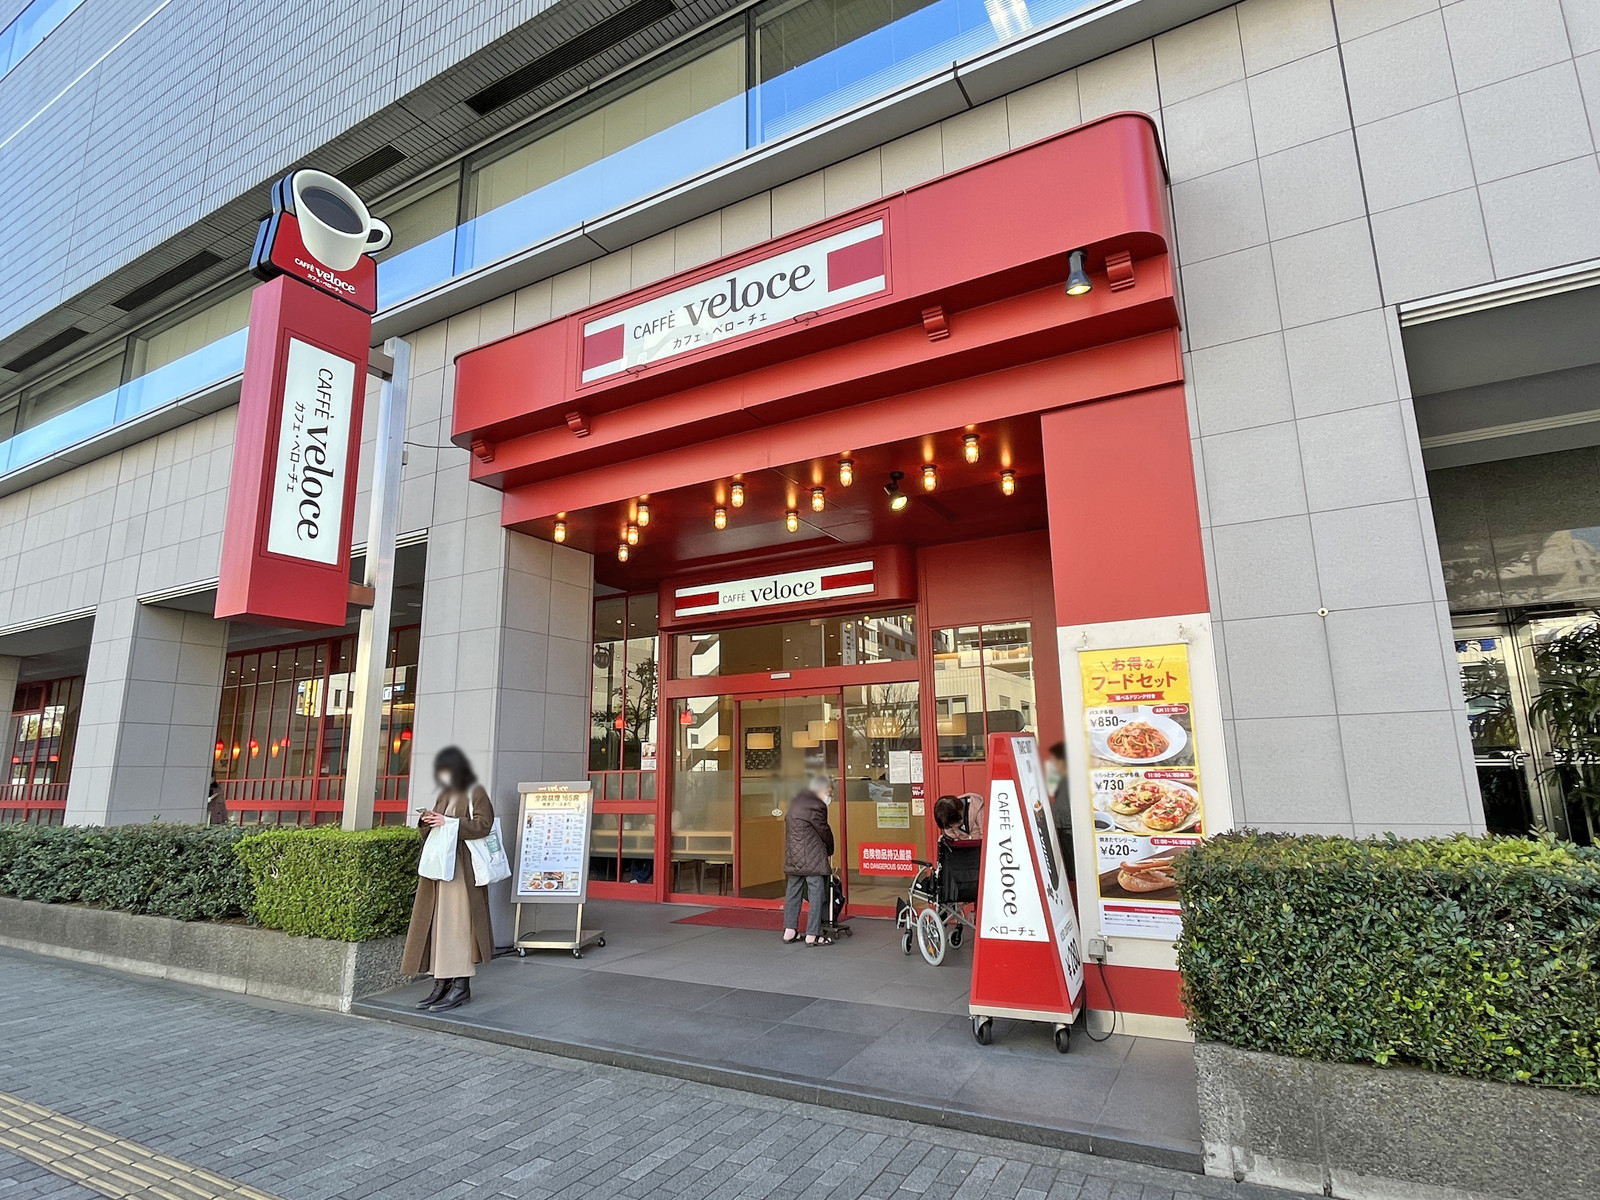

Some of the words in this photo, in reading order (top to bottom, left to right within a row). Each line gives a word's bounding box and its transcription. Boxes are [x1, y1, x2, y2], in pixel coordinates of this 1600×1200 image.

[294, 257, 314, 272] CAFFÈ
[315, 267, 356, 294] veloce
[633, 310, 677, 340] CAFFÈ
[683, 264, 815, 326] veloce
[673, 312, 768, 350] カフェ・ベローチェ
[314, 368, 335, 420] CAFFÈ
[286, 401, 306, 492] カフェ・ベローチェ
[296, 425, 335, 541] veloce
[722, 591, 746, 604] CAFFÈ
[750, 580, 818, 603] veloce
[1091, 671, 1178, 691] フードセット
[1111, 656, 1155, 671] お得な
[1095, 779, 1124, 791] ¥730
[996, 791, 1014, 831] CAFFÈ
[998, 837, 1021, 918] veloce
[989, 925, 1037, 937] ベローチェ
